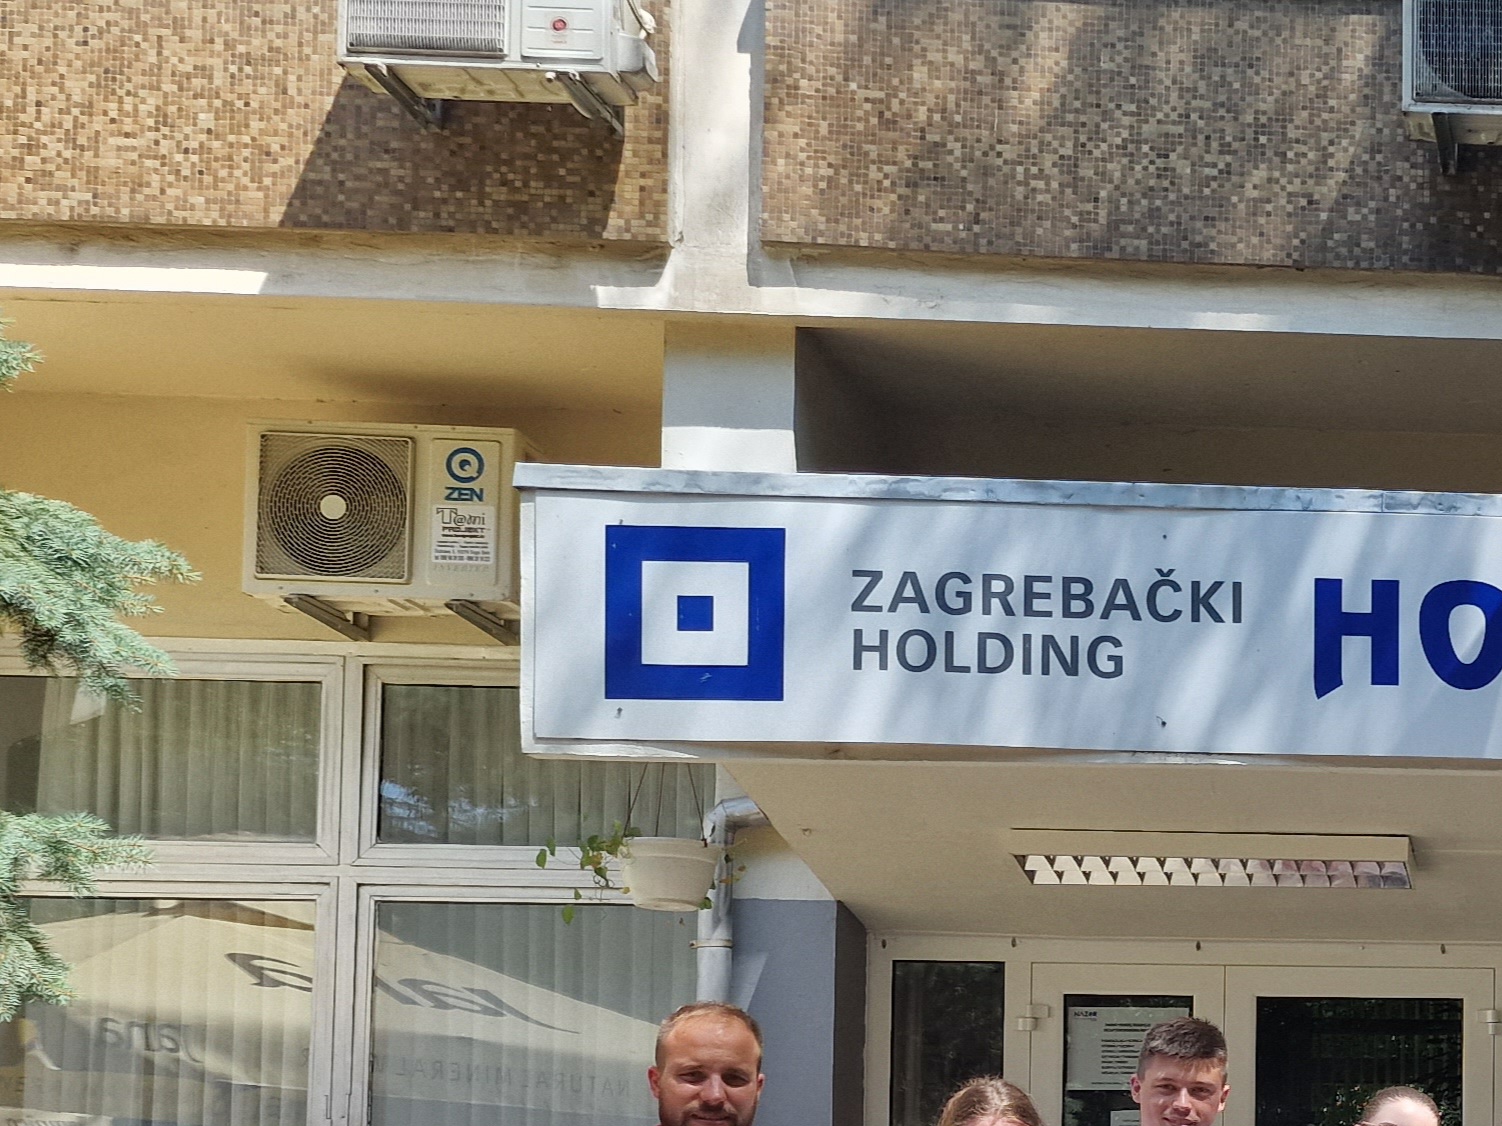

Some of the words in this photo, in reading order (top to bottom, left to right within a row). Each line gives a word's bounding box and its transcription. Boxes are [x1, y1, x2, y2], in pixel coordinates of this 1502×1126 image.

[444, 486, 484, 502] ZEN
[851, 567, 1243, 625] ZAGREBAČKI
[853, 628, 1125, 680] HOLDING
